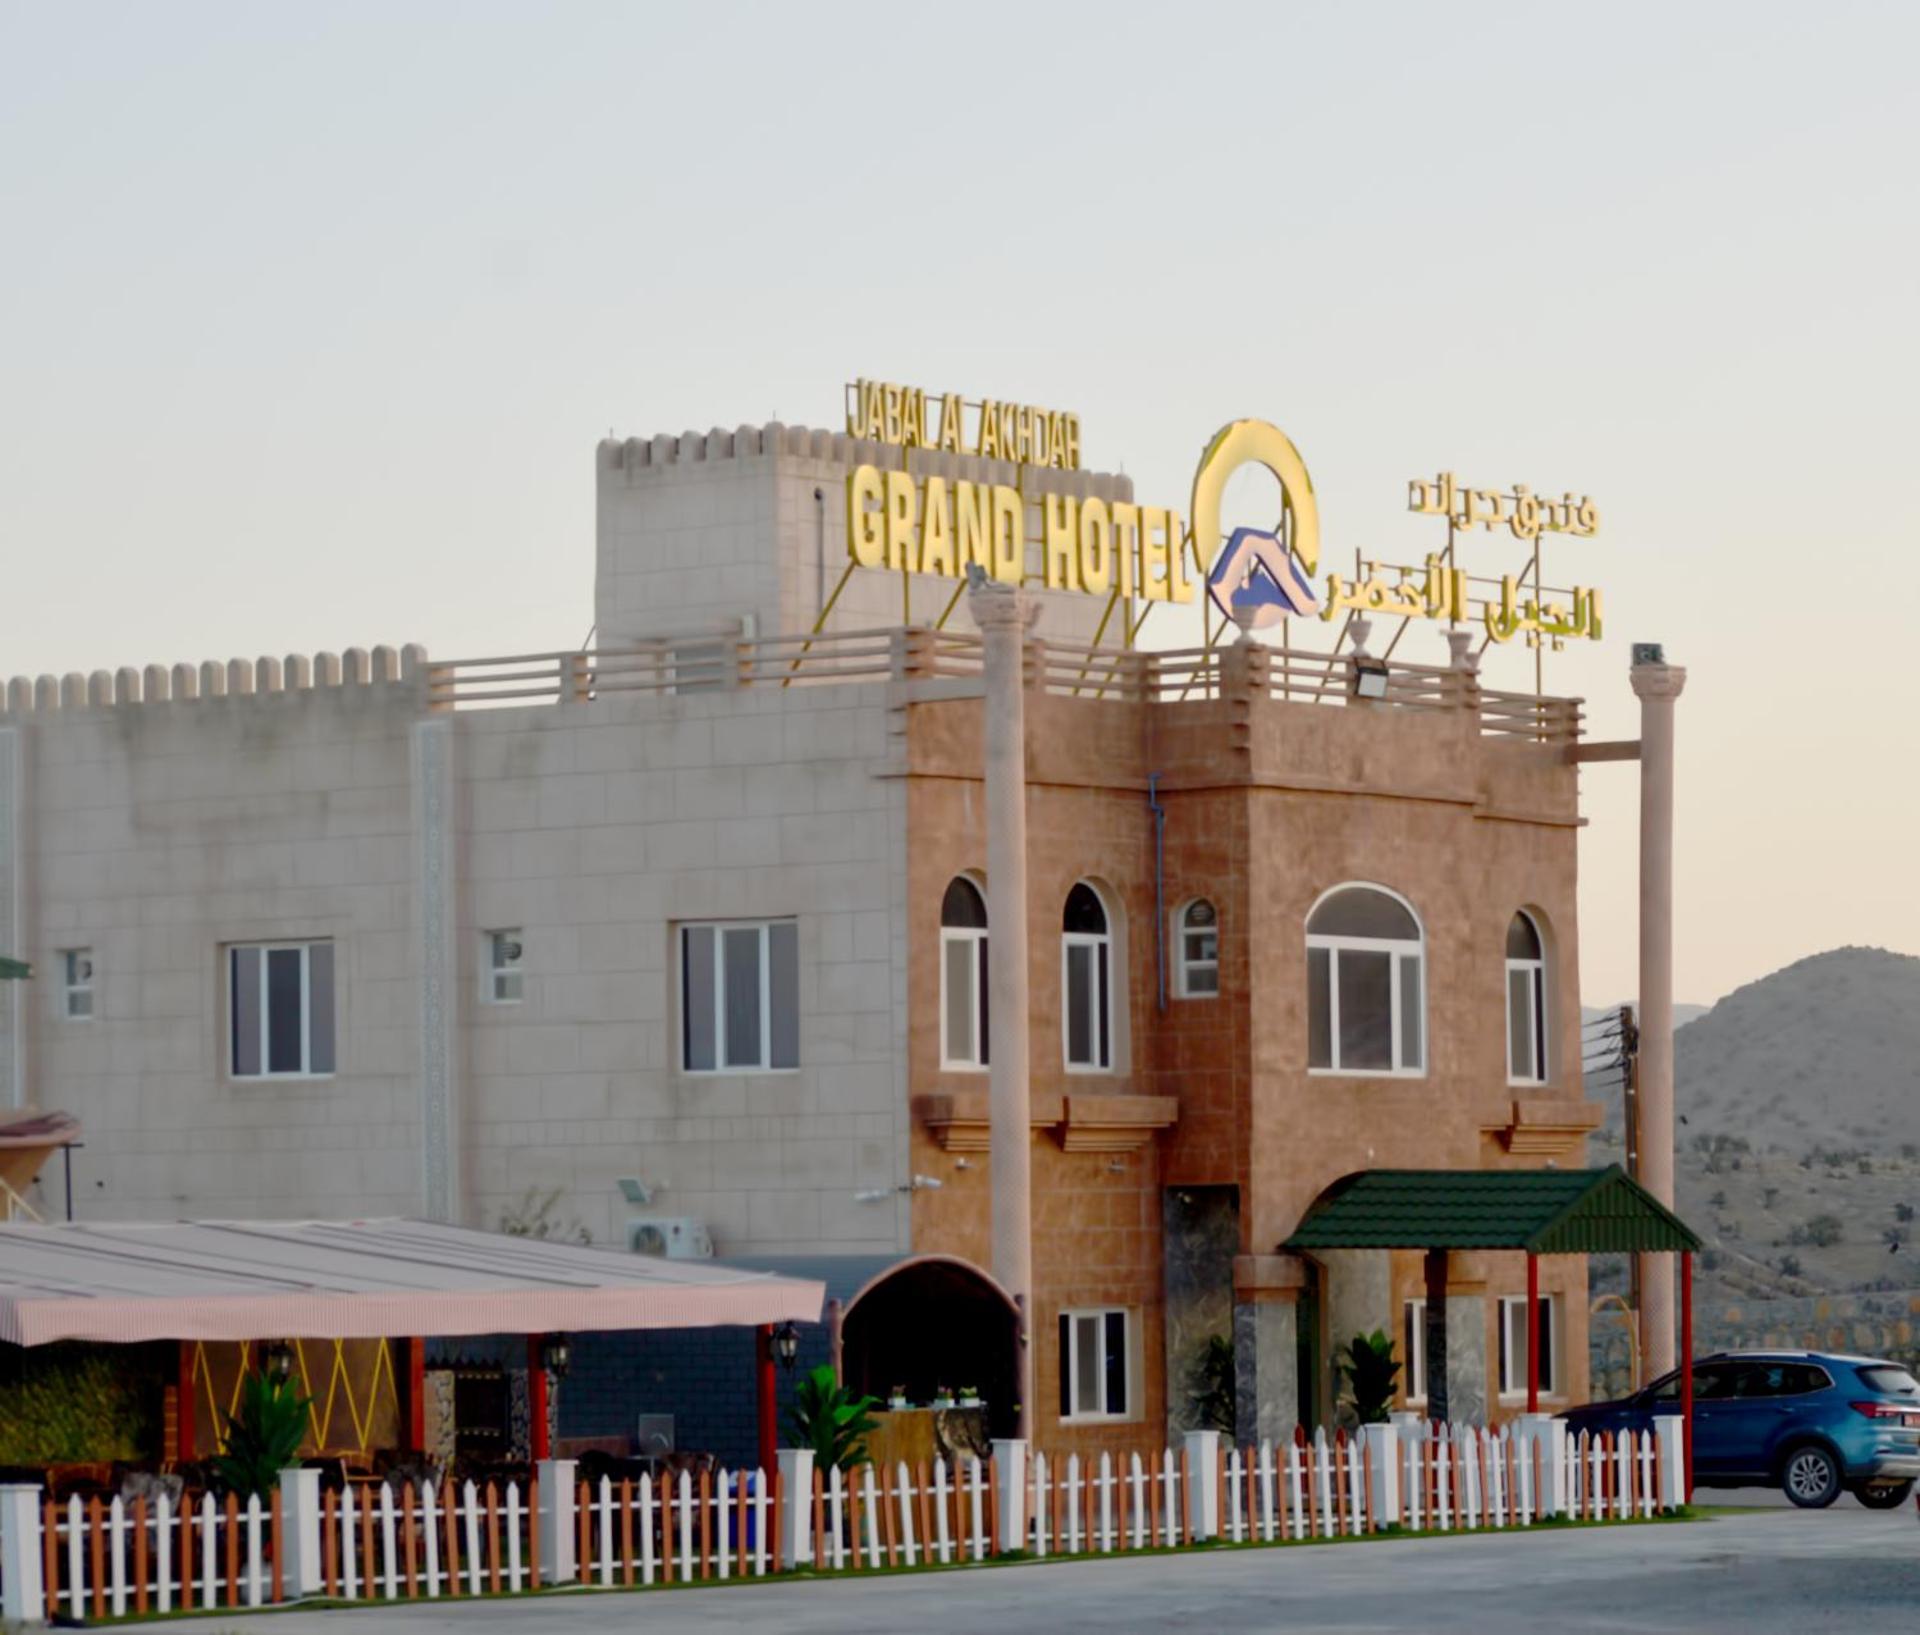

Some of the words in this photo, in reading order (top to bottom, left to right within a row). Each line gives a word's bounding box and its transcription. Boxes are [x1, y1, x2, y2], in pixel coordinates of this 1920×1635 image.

[848, 377, 939, 450] JABAL
[939, 392, 979, 455] AL
[979, 399, 1081, 471] AKHDAR
[847, 464, 1025, 587] GRAND
[1042, 493, 1194, 604] HOTEL
[1407, 471, 1505, 531] جراند
[1510, 484, 1601, 540] فندق
[1318, 552, 1466, 622] الأخضر
[1484, 574, 1602, 652] الجبل
